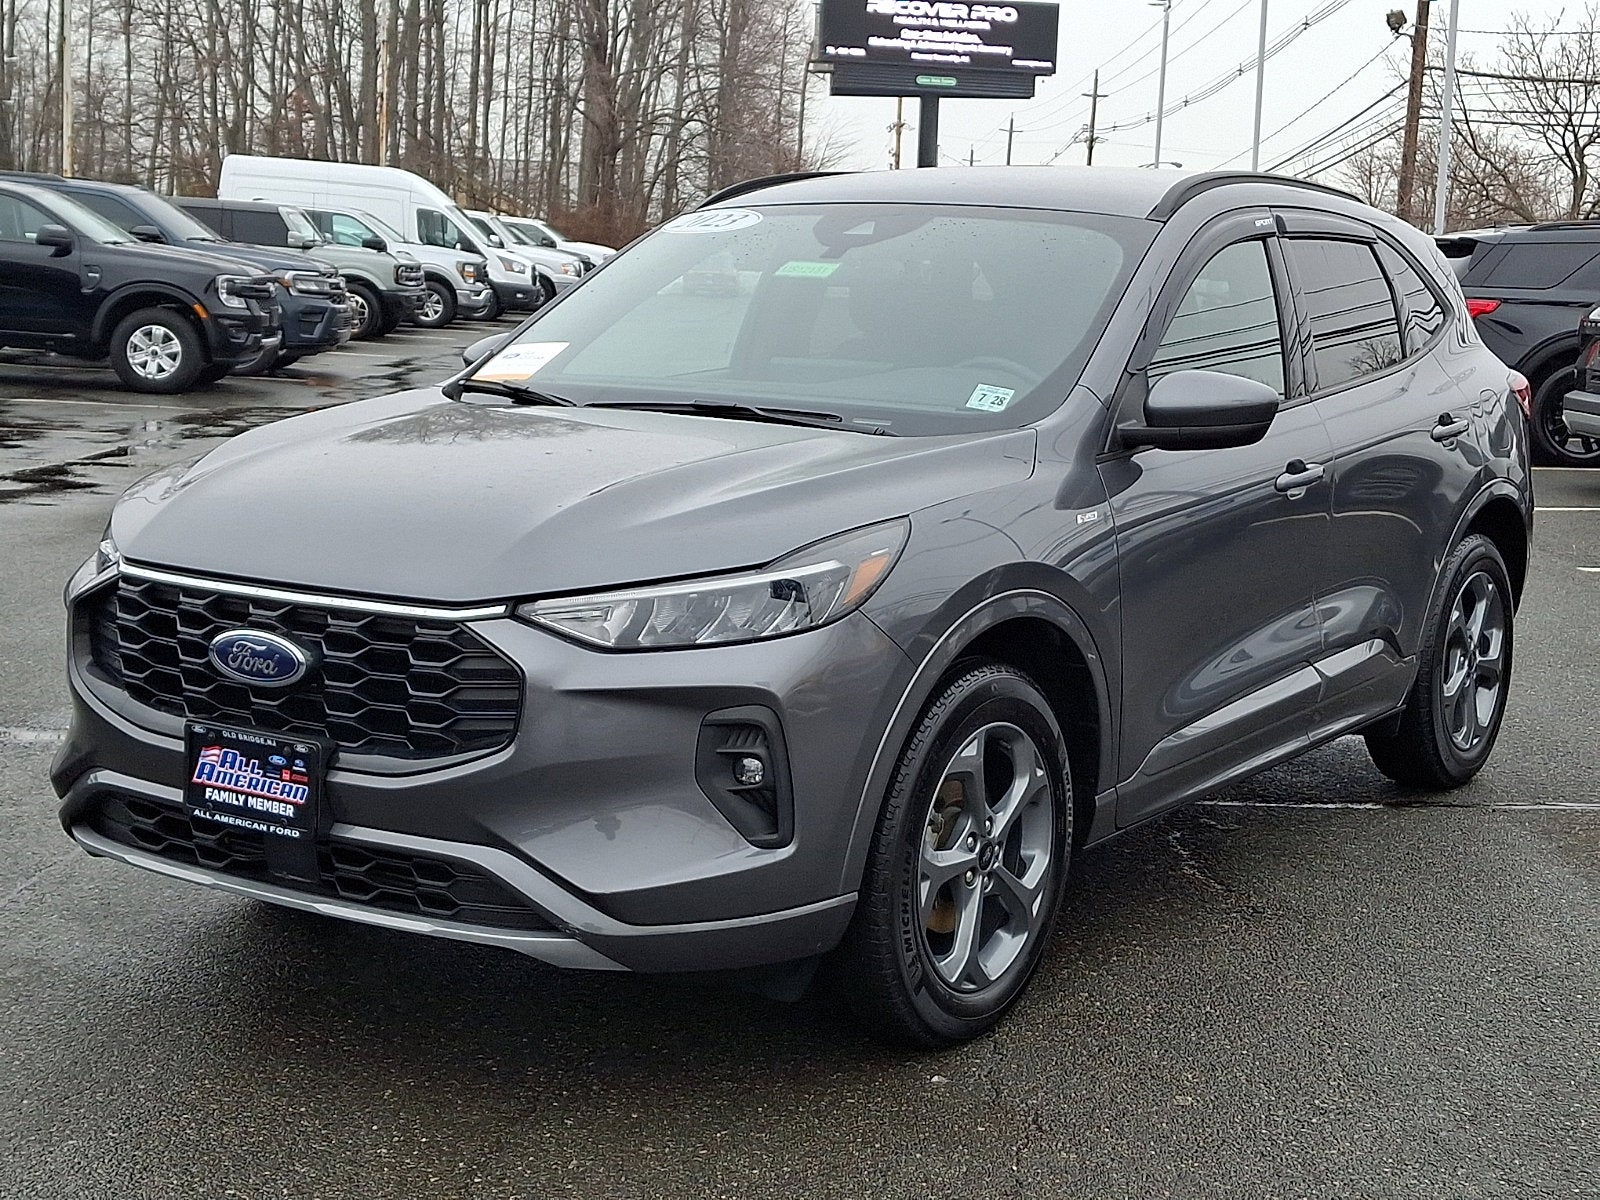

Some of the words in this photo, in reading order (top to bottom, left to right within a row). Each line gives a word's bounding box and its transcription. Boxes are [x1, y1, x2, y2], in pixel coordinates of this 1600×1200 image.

[970, 4, 1018, 22] PRO
[978, 393, 987, 402] 7
[990, 395, 1006, 406] 28
[227, 640, 278, 675] Ford
[222, 730, 236, 739] OLD
[194, 760, 309, 803] AMERICAN
[205, 787, 246, 807] FAMILY
[248, 796, 295, 818] MEMBER
[193, 808, 212, 819] ALL
[213, 813, 267, 831] AMERICAN
[269, 825, 300, 838] FORD
